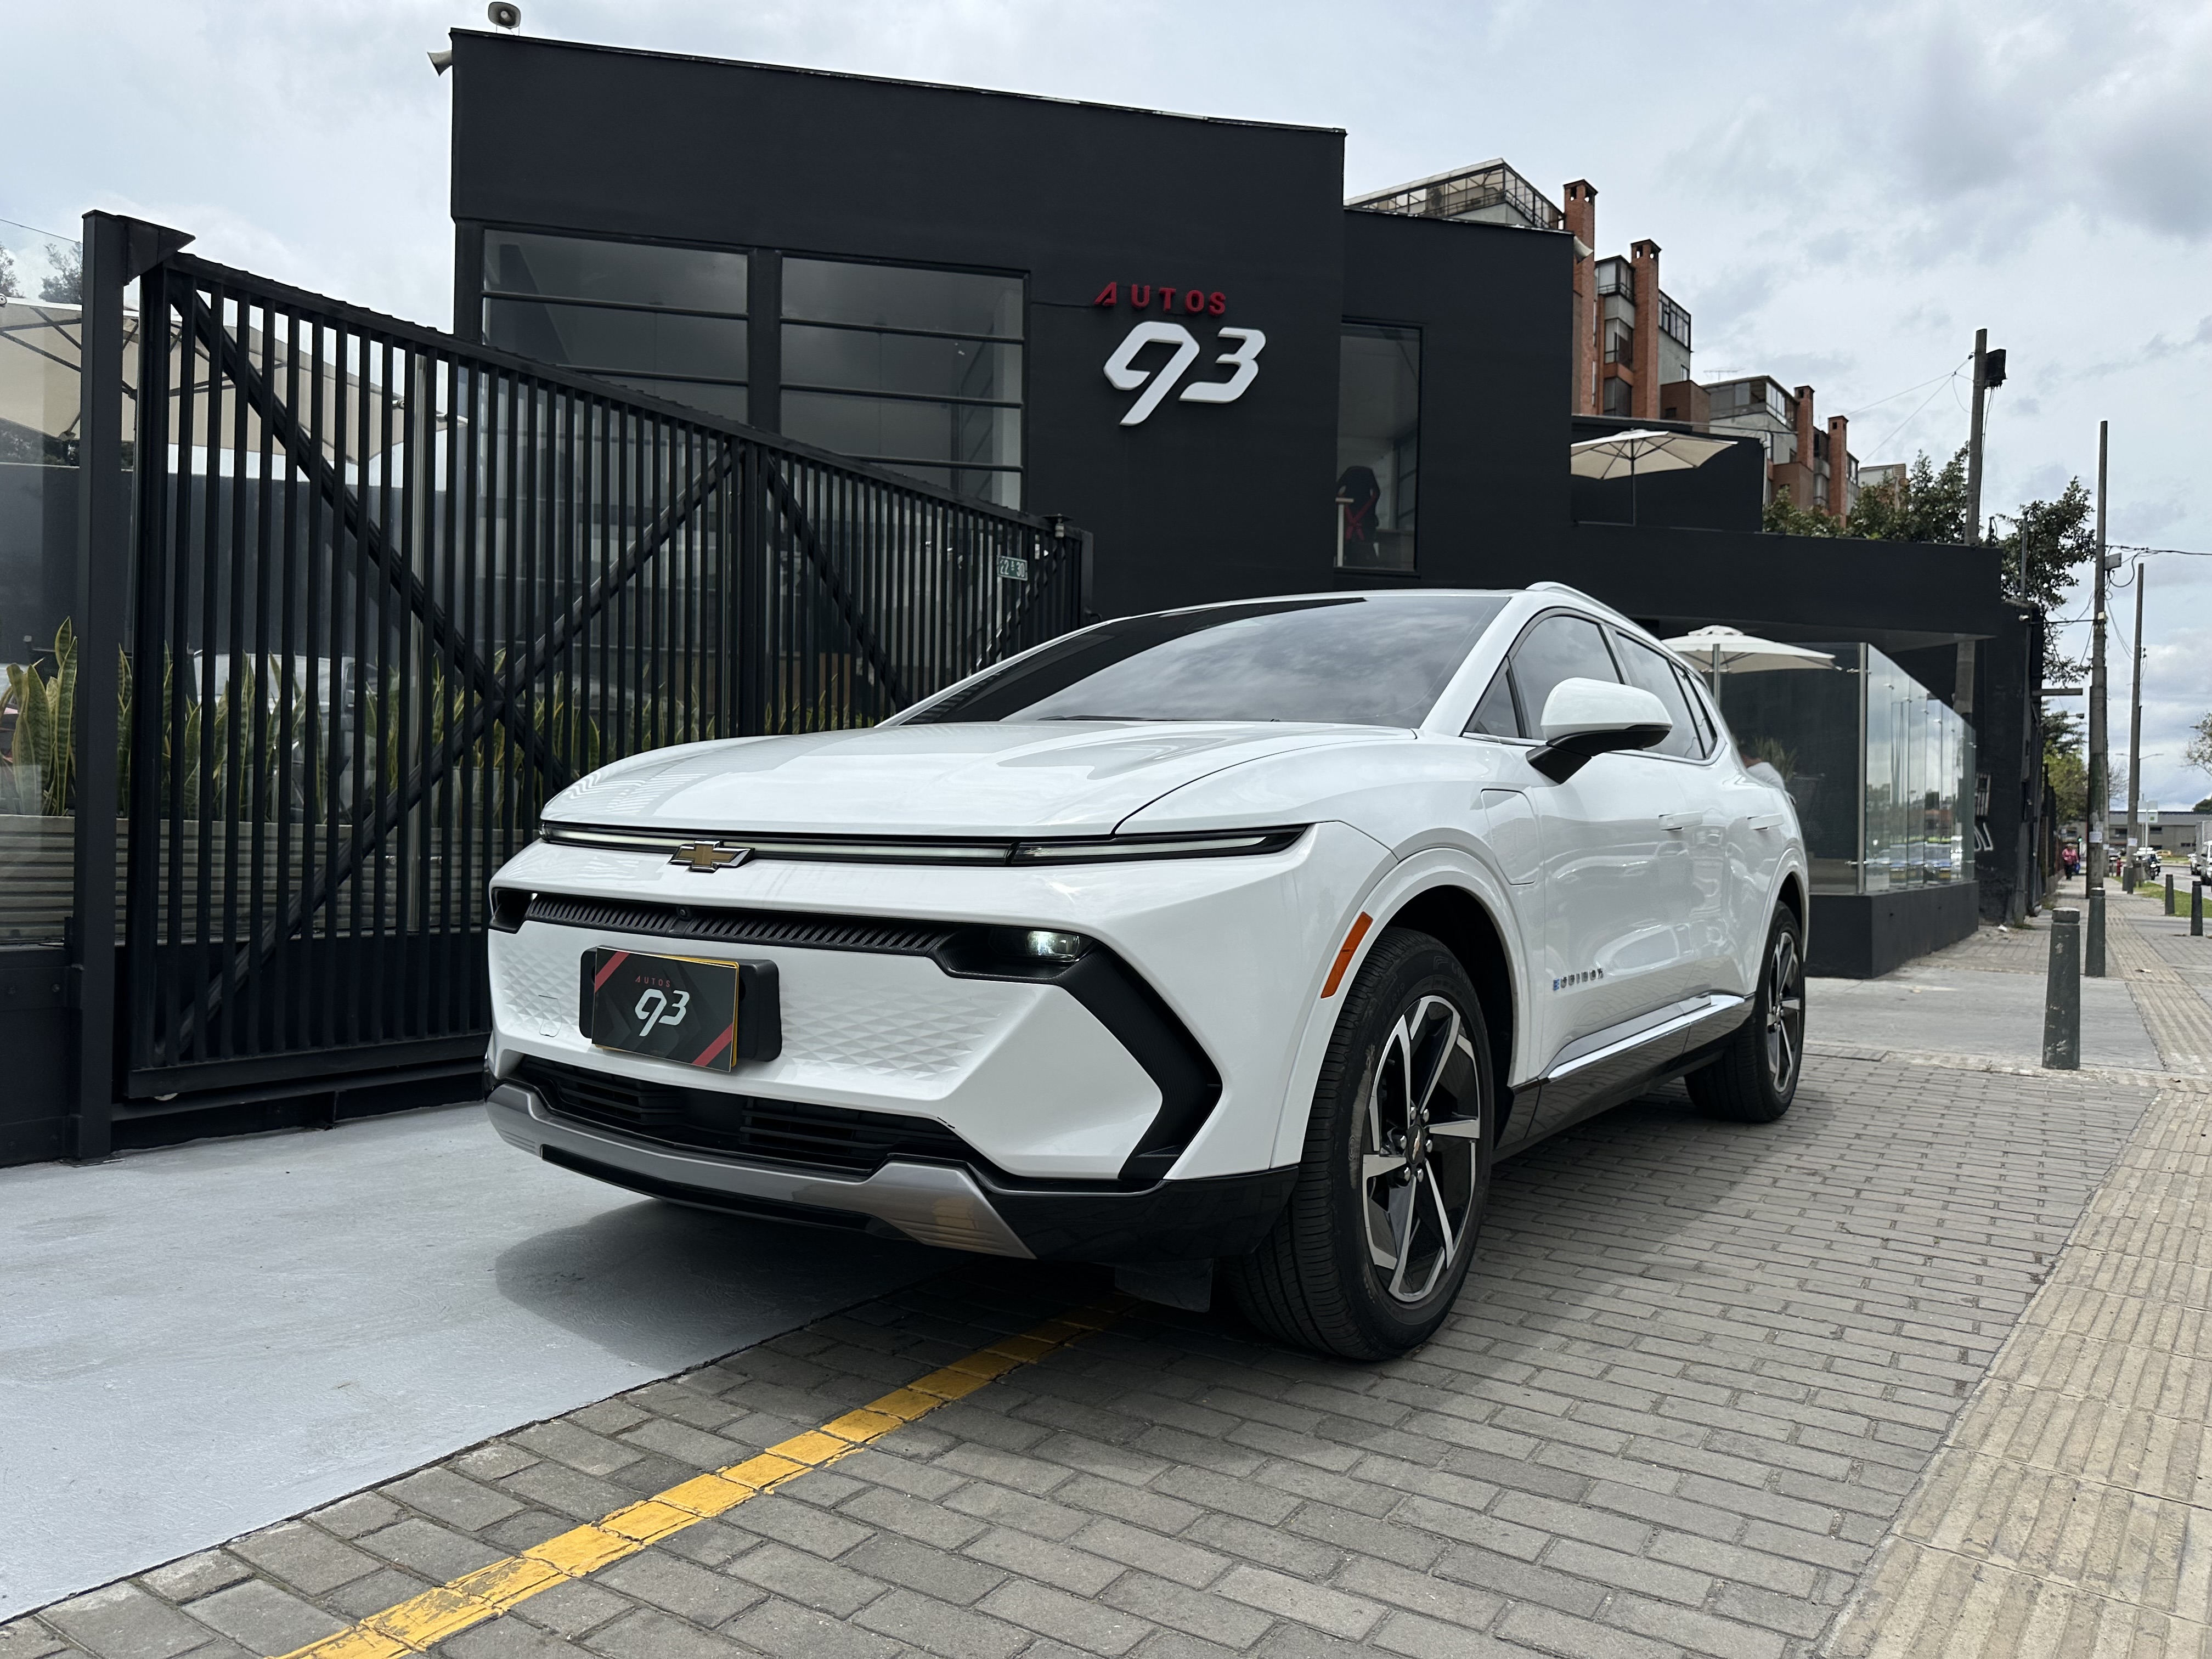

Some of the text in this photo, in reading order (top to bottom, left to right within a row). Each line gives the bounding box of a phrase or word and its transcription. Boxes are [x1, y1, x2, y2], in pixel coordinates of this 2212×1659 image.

[1094, 282, 1226, 317] AUTOS
[1103, 321, 1267, 426] 93
[635, 975, 670, 988] AUTOS
[634, 988, 690, 1037] 93
